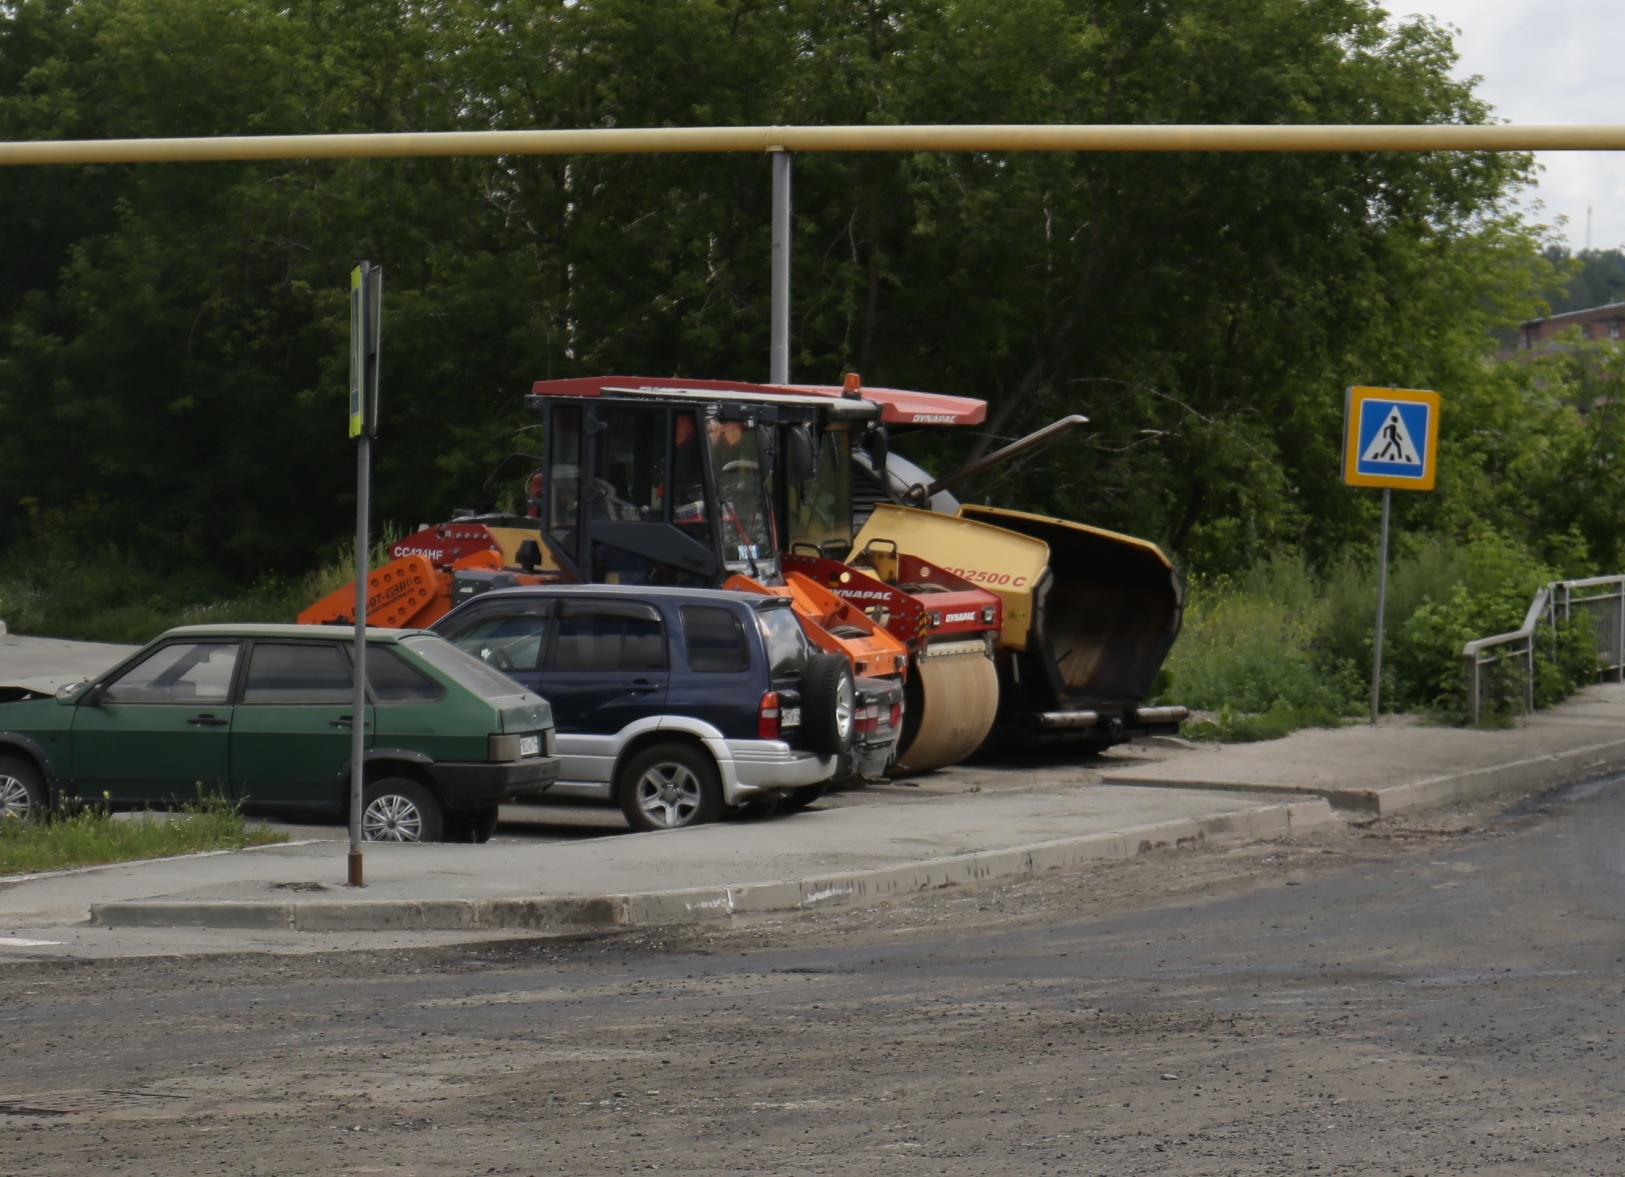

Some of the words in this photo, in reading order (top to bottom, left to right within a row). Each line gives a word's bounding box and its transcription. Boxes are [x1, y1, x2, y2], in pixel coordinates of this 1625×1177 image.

[912, 414, 957, 424] DYNAPAC
[831, 589, 892, 600] YNAPAC
[945, 611, 976, 623] DYNAPAC
